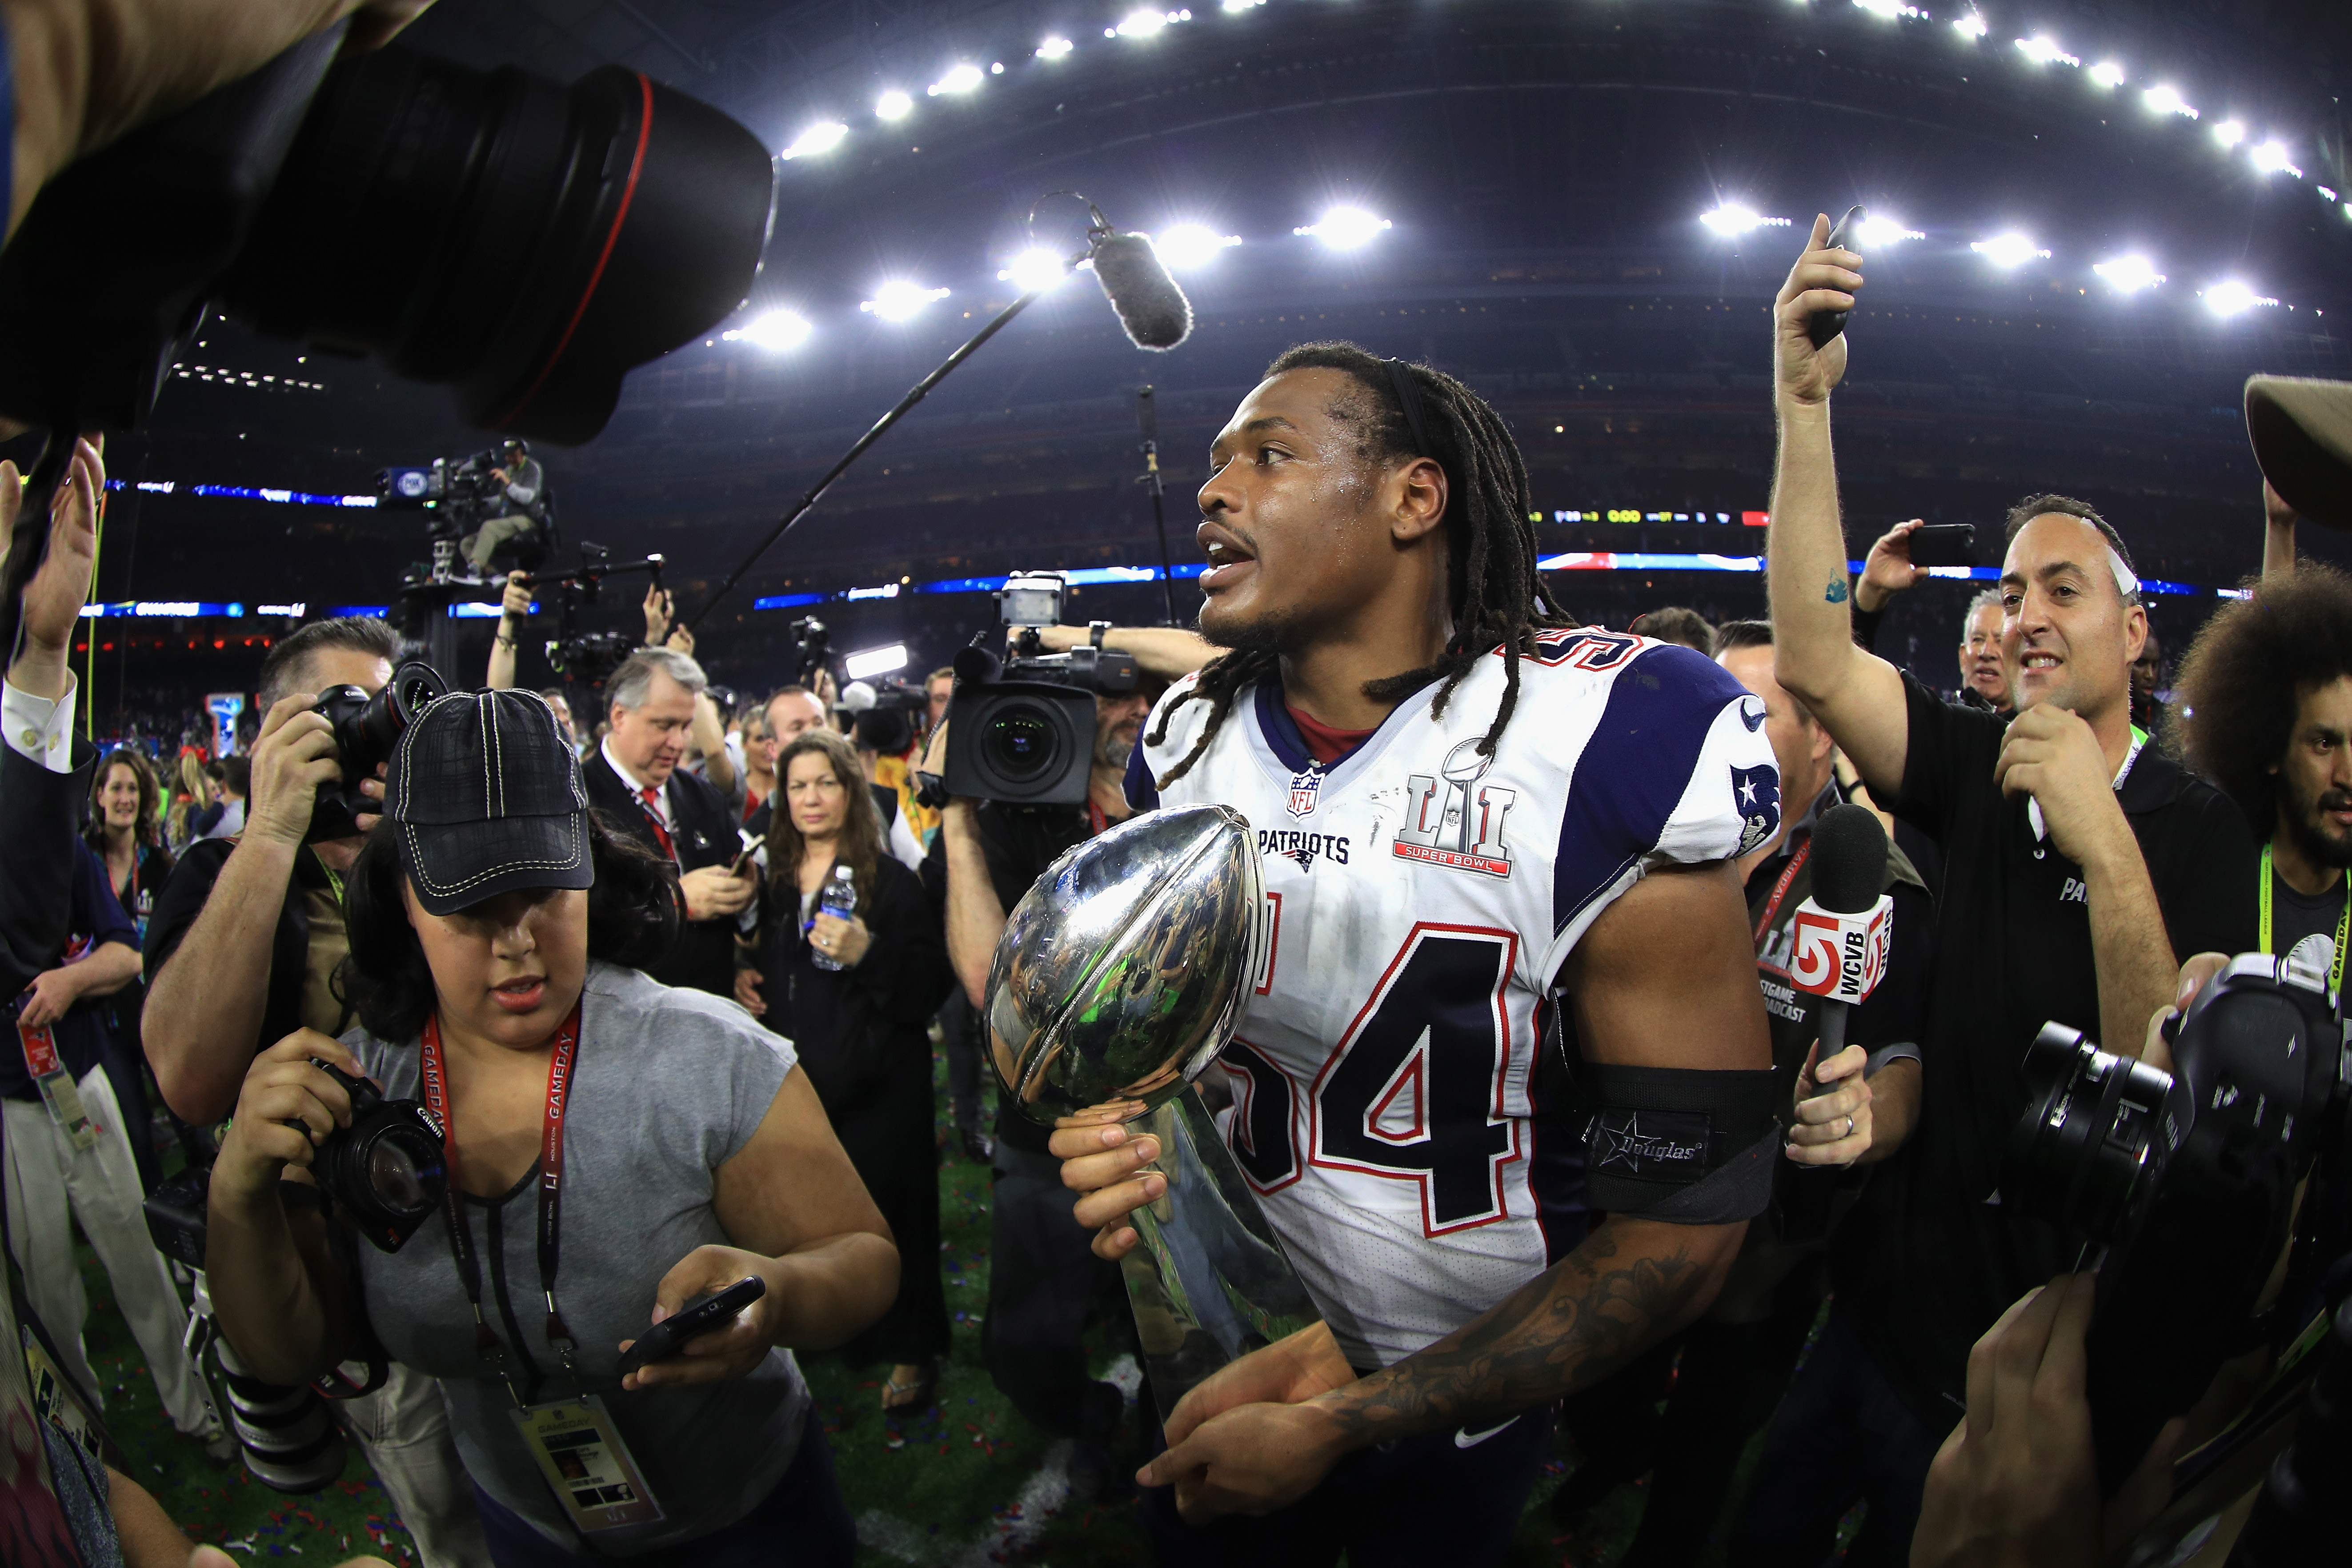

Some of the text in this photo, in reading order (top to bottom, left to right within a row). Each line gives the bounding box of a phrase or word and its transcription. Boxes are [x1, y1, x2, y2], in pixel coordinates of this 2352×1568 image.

[1289, 791, 1312, 812] NFL
[1399, 774, 1516, 860] LI
[1259, 830, 1350, 865] PATRIOTS
[1405, 846, 1493, 871] SUPER BOWL
[1772, 847, 1807, 902] GAMEDAY
[2059, 877, 2088, 906] PA
[1791, 912, 1841, 996] 5
[1840, 931, 1865, 996] WCVB
[1880, 909, 1893, 976] WCVB
[2332, 910, 2347, 980] GAMEDAY
[425, 1045, 446, 1132] GAMEDAY
[549, 1031, 573, 1119] GAMEDAY
[416, 1107, 443, 1138] Canon
[1619, 1135, 1695, 1163] Douglas
[545, 1171, 558, 1190] LI
